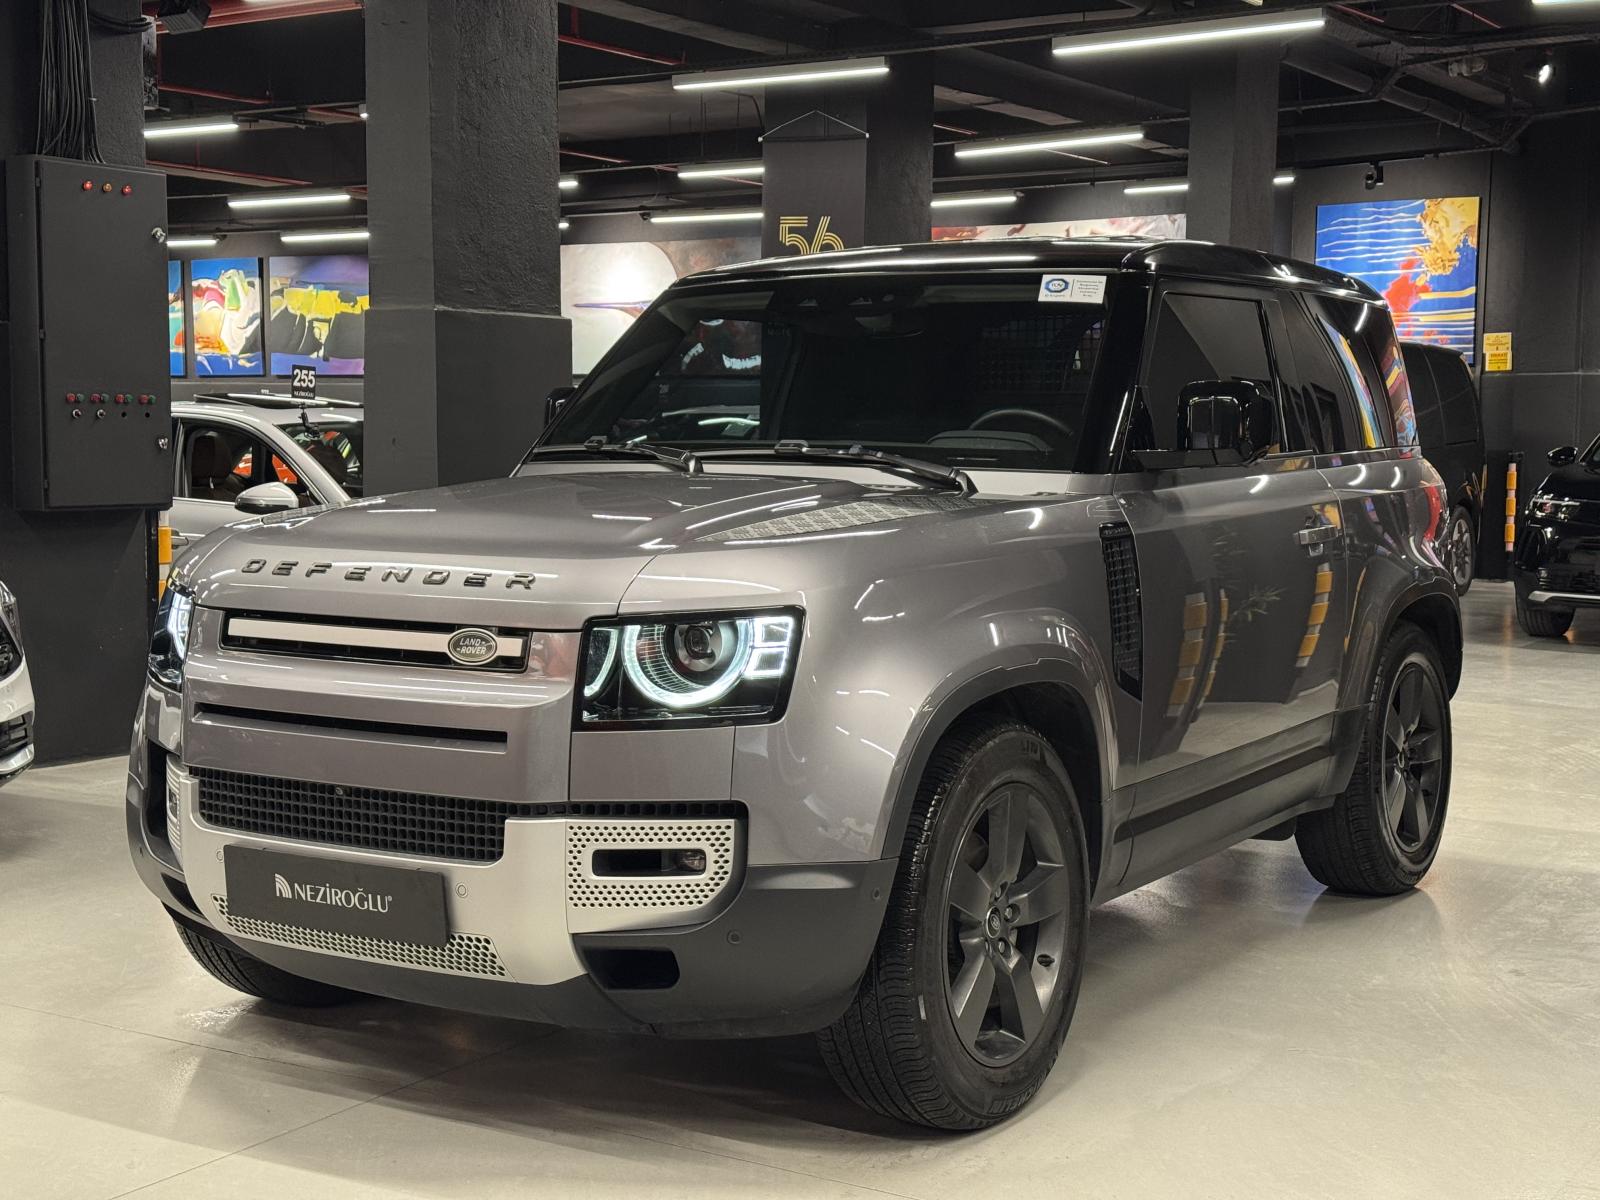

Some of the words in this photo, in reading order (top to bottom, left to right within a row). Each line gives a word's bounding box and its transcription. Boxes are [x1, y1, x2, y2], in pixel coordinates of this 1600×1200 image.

[779, 215, 845, 255] 56
[293, 368, 316, 388] 255
[241, 558, 537, 590] DEFENDER
[460, 637, 482, 647] LAND
[460, 645, 487, 655] ROVER
[294, 882, 390, 913] NEZİROĞLU
